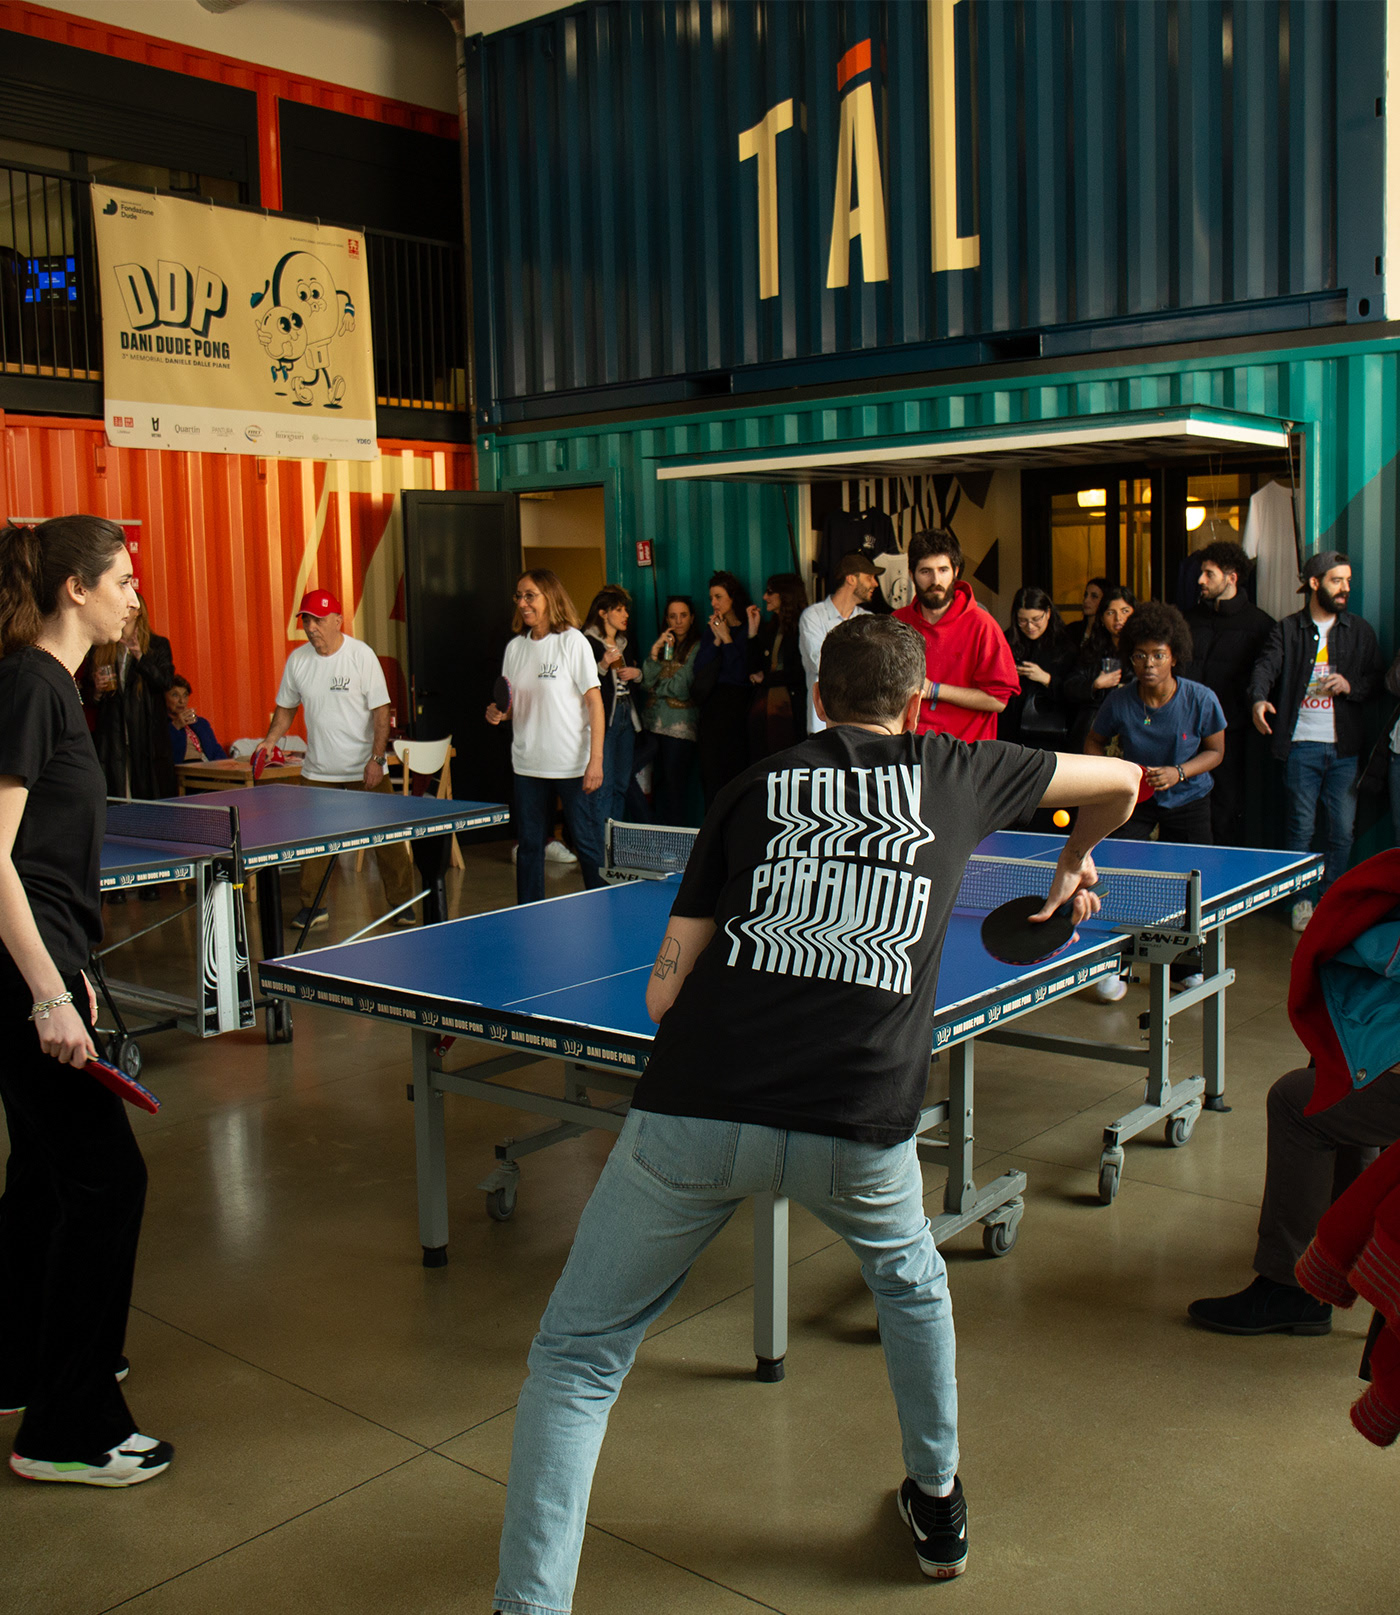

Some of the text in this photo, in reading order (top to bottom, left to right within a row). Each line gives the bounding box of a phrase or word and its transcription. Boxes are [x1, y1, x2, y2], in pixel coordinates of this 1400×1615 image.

[121, 204, 154, 216] Fondazione
[121, 211, 137, 220] Dude
[113, 259, 228, 338] DDP
[120, 331, 231, 360] DANI DUDE PONG
[130, 354, 164, 364] MEMORIAL
[165, 358, 192, 366] DANIELE
[193, 360, 211, 368] DALLE
[212, 362, 231, 370] PIANE
[1301, 695, 1335, 710] Kod
[766, 763, 936, 866] HEALTHY
[724, 857, 932, 995] PARANOIA
[511, 1030, 525, 1042] DANI
[525, 1033, 540, 1046] DUDE
[541, 1036, 557, 1049] PONG
[587, 1046, 601, 1058] DANI
[602, 1048, 618, 1062] DUDE
[618, 1052, 636, 1065] PONG
